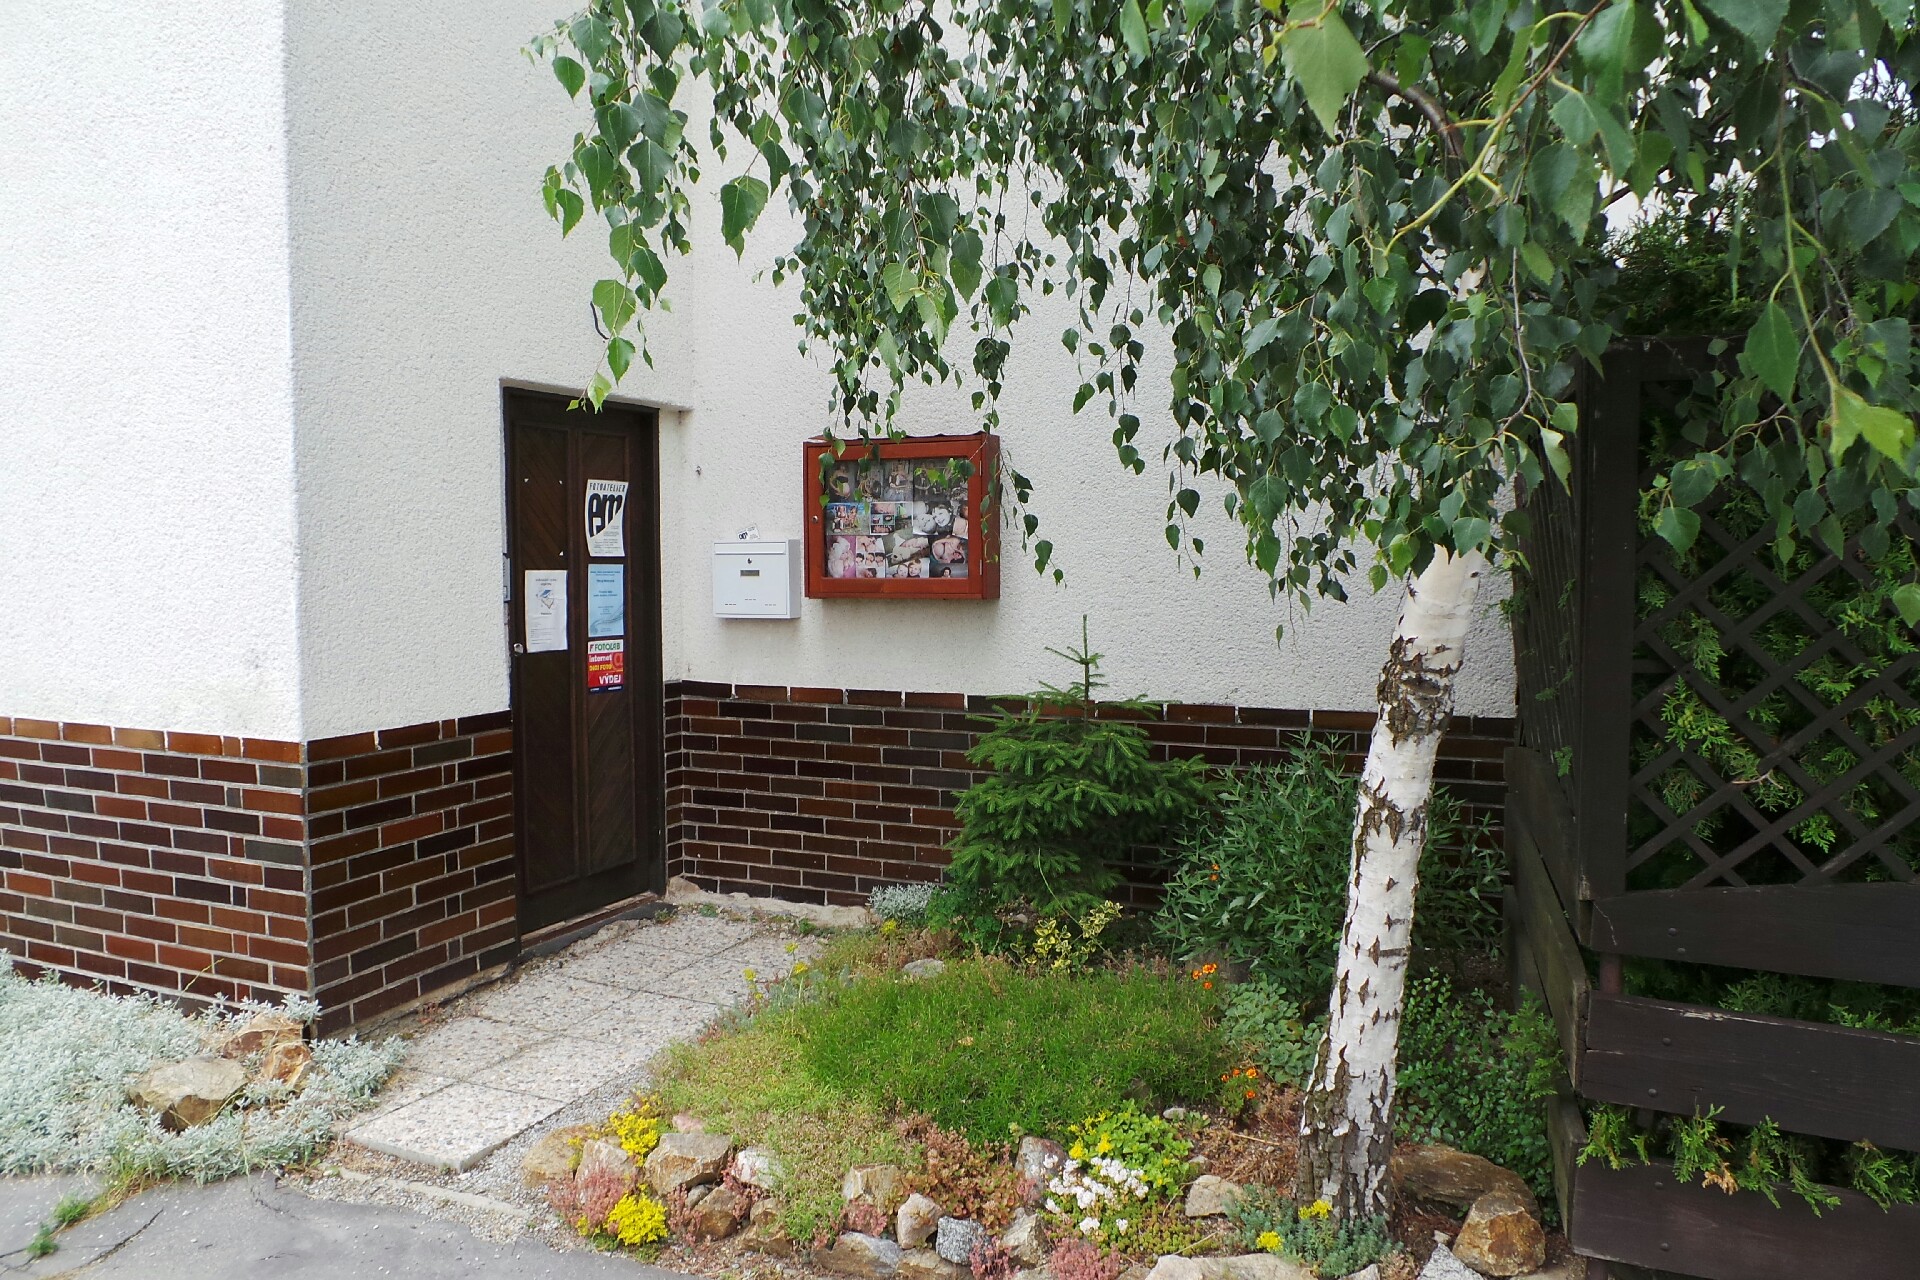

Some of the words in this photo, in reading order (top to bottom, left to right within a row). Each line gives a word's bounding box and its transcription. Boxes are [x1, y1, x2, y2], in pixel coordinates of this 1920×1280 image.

[589, 483, 626, 492] FOTOATELIER
[595, 643, 621, 651] FOTOLAB
[599, 673, 621, 685] VÝDEJ
